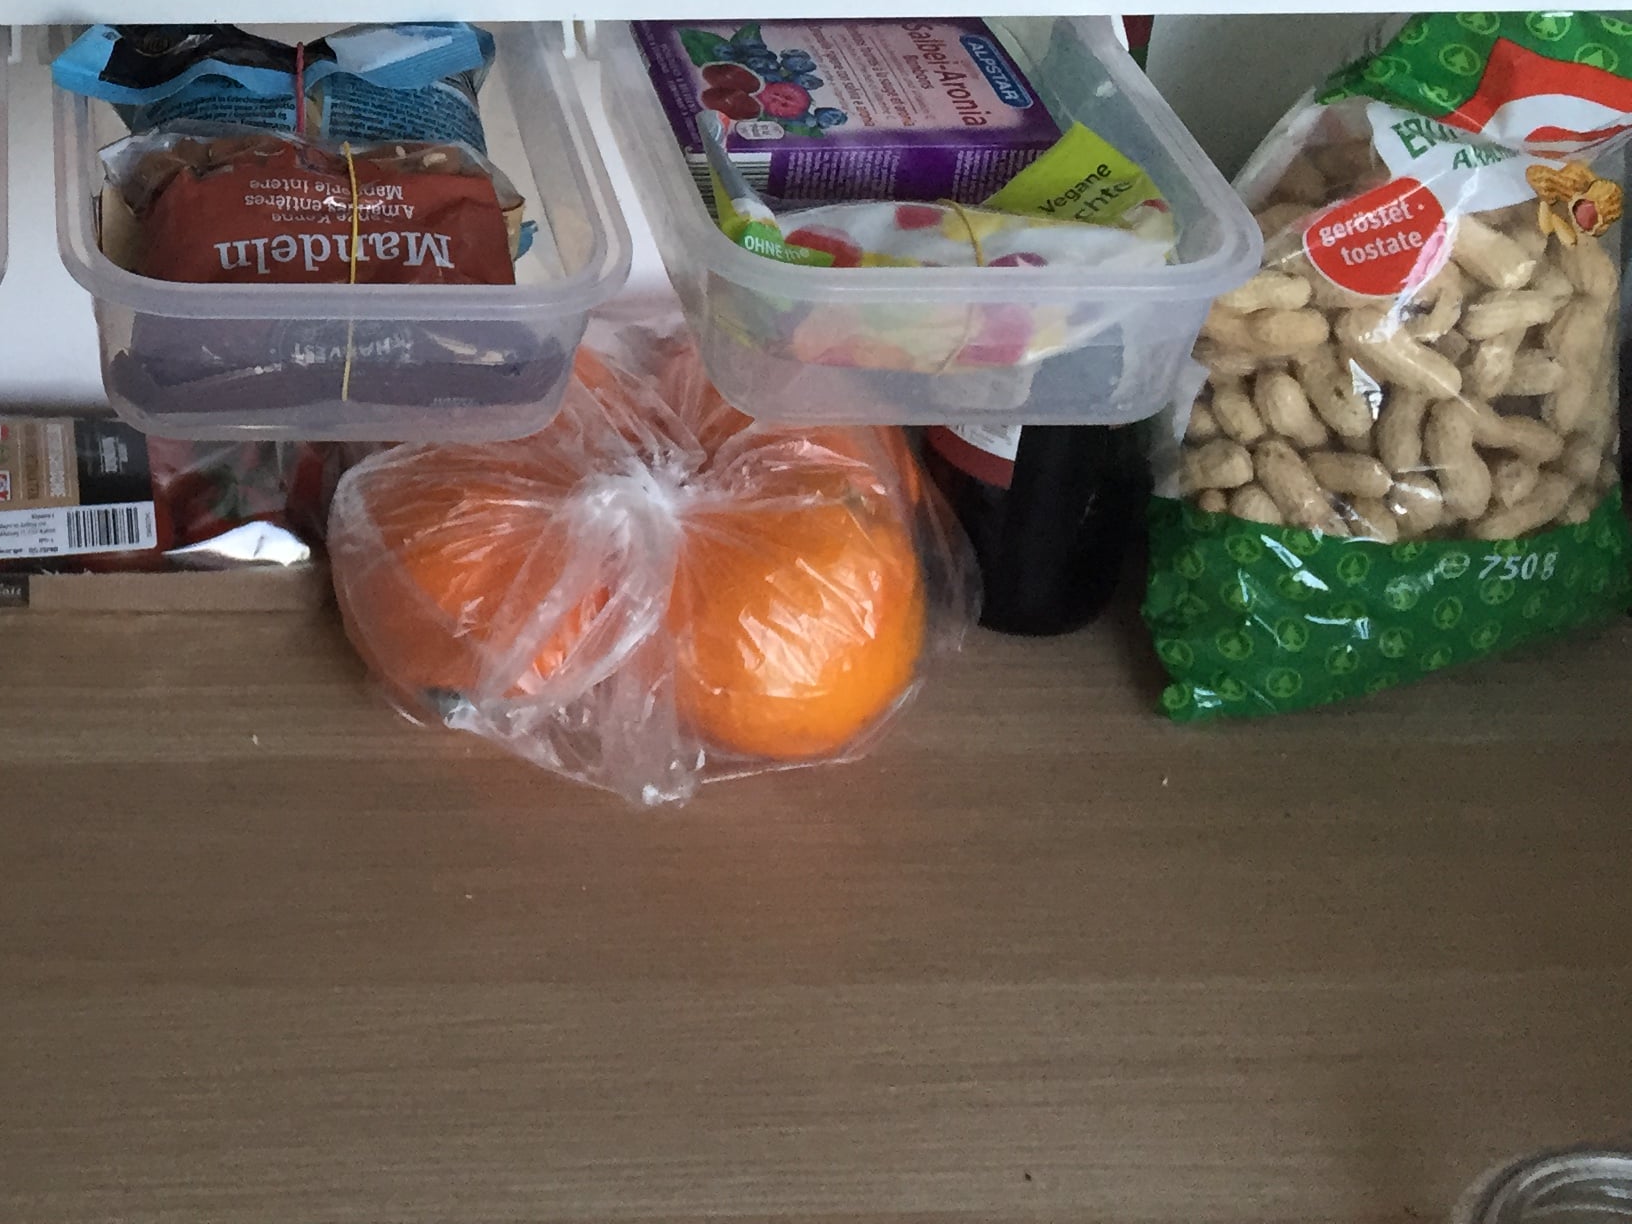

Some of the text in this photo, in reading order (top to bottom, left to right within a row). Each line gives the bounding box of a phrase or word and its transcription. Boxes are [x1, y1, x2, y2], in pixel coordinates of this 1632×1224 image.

[968, 40, 1020, 101] ALPSTAR
[1037, 163, 1112, 216] Vegane
[1318, 199, 1415, 248] geröstet
[213, 231, 455, 274] Mandeln
[743, 234, 783, 260] OHNE
[1340, 230, 1424, 266] tostate
